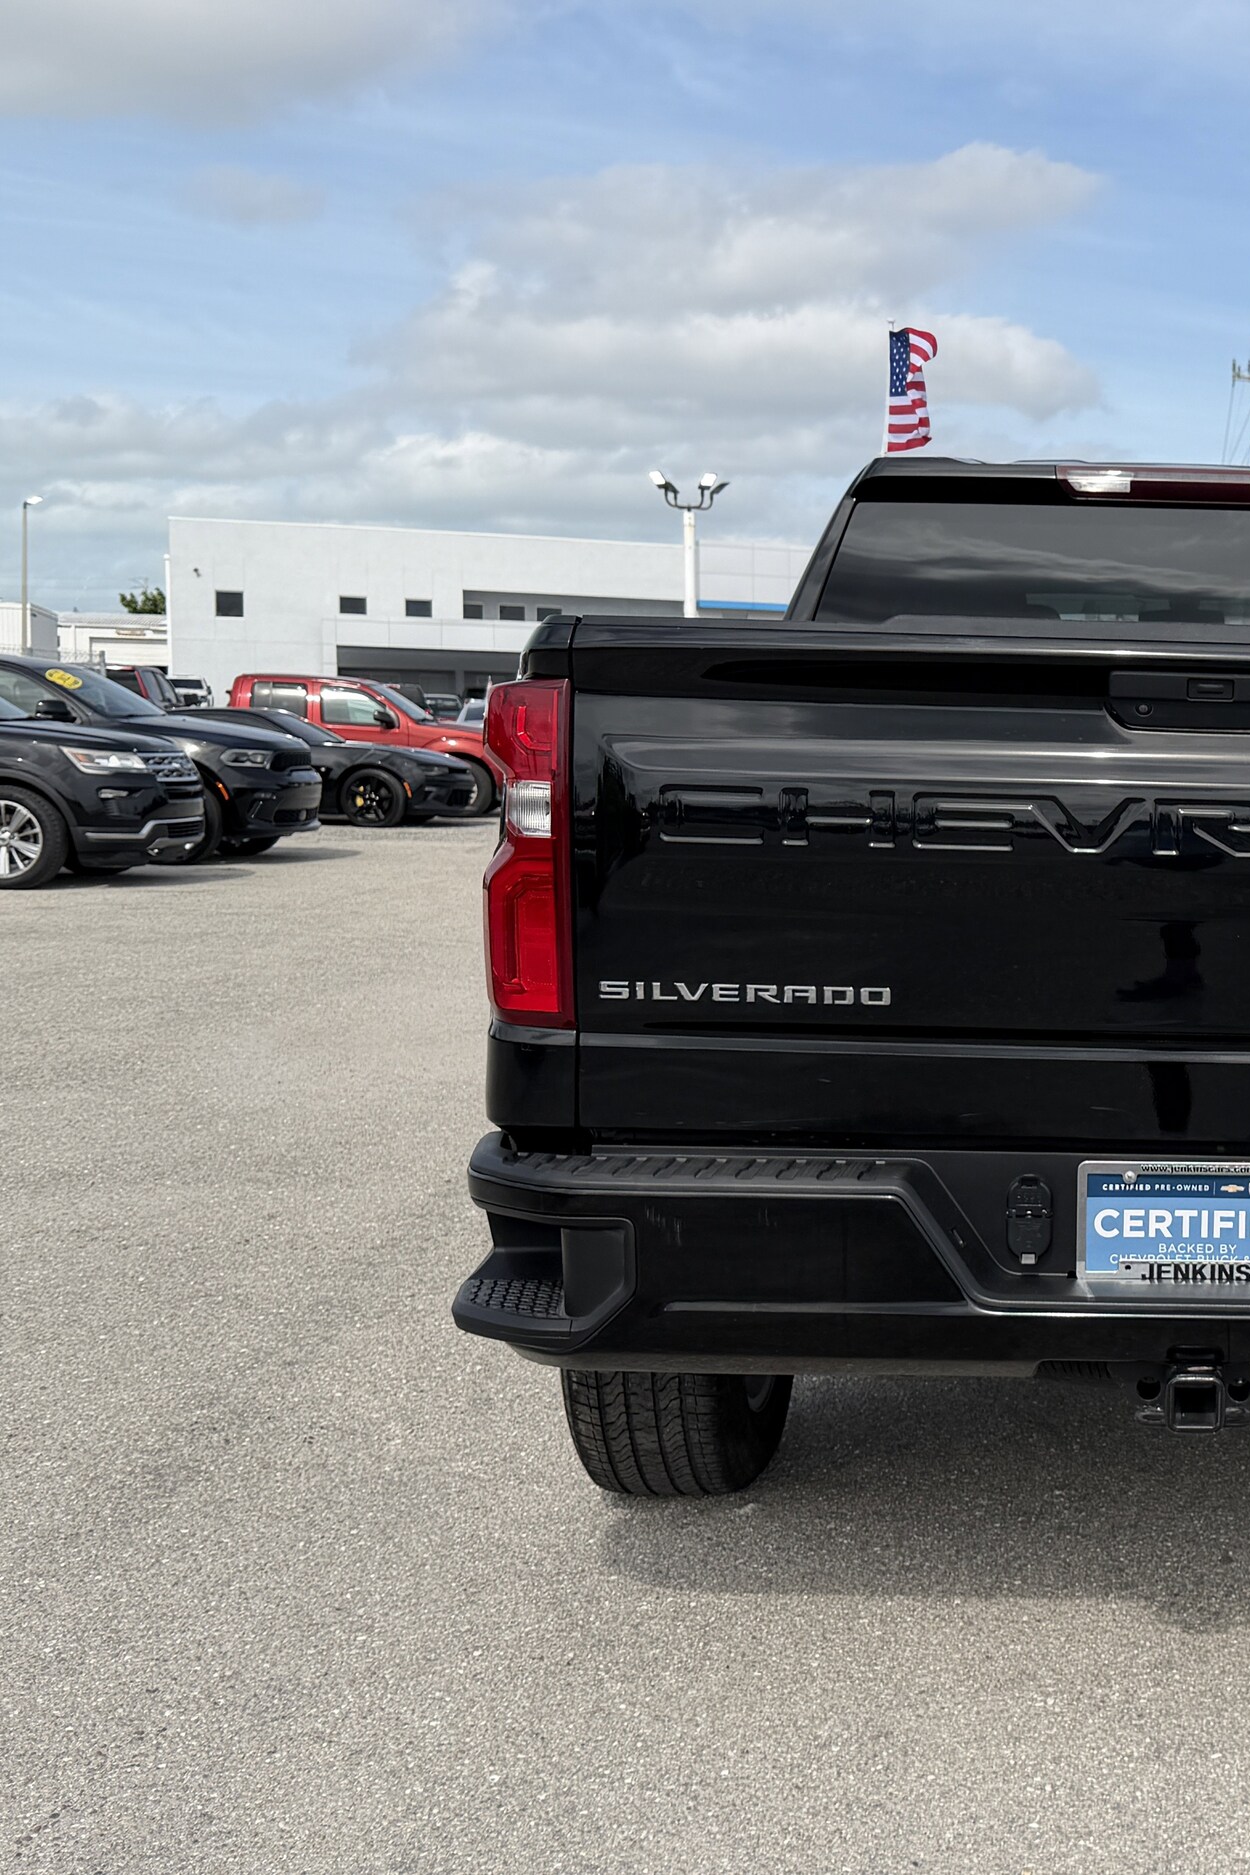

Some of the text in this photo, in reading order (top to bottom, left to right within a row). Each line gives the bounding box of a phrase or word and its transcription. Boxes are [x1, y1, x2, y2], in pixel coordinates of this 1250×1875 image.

[599, 980, 892, 1006] SILVERADO
[1102, 1184, 1210, 1193] CERTIFIED PRE-OWNED
[1158, 1243, 1237, 1254] BACKED BY
